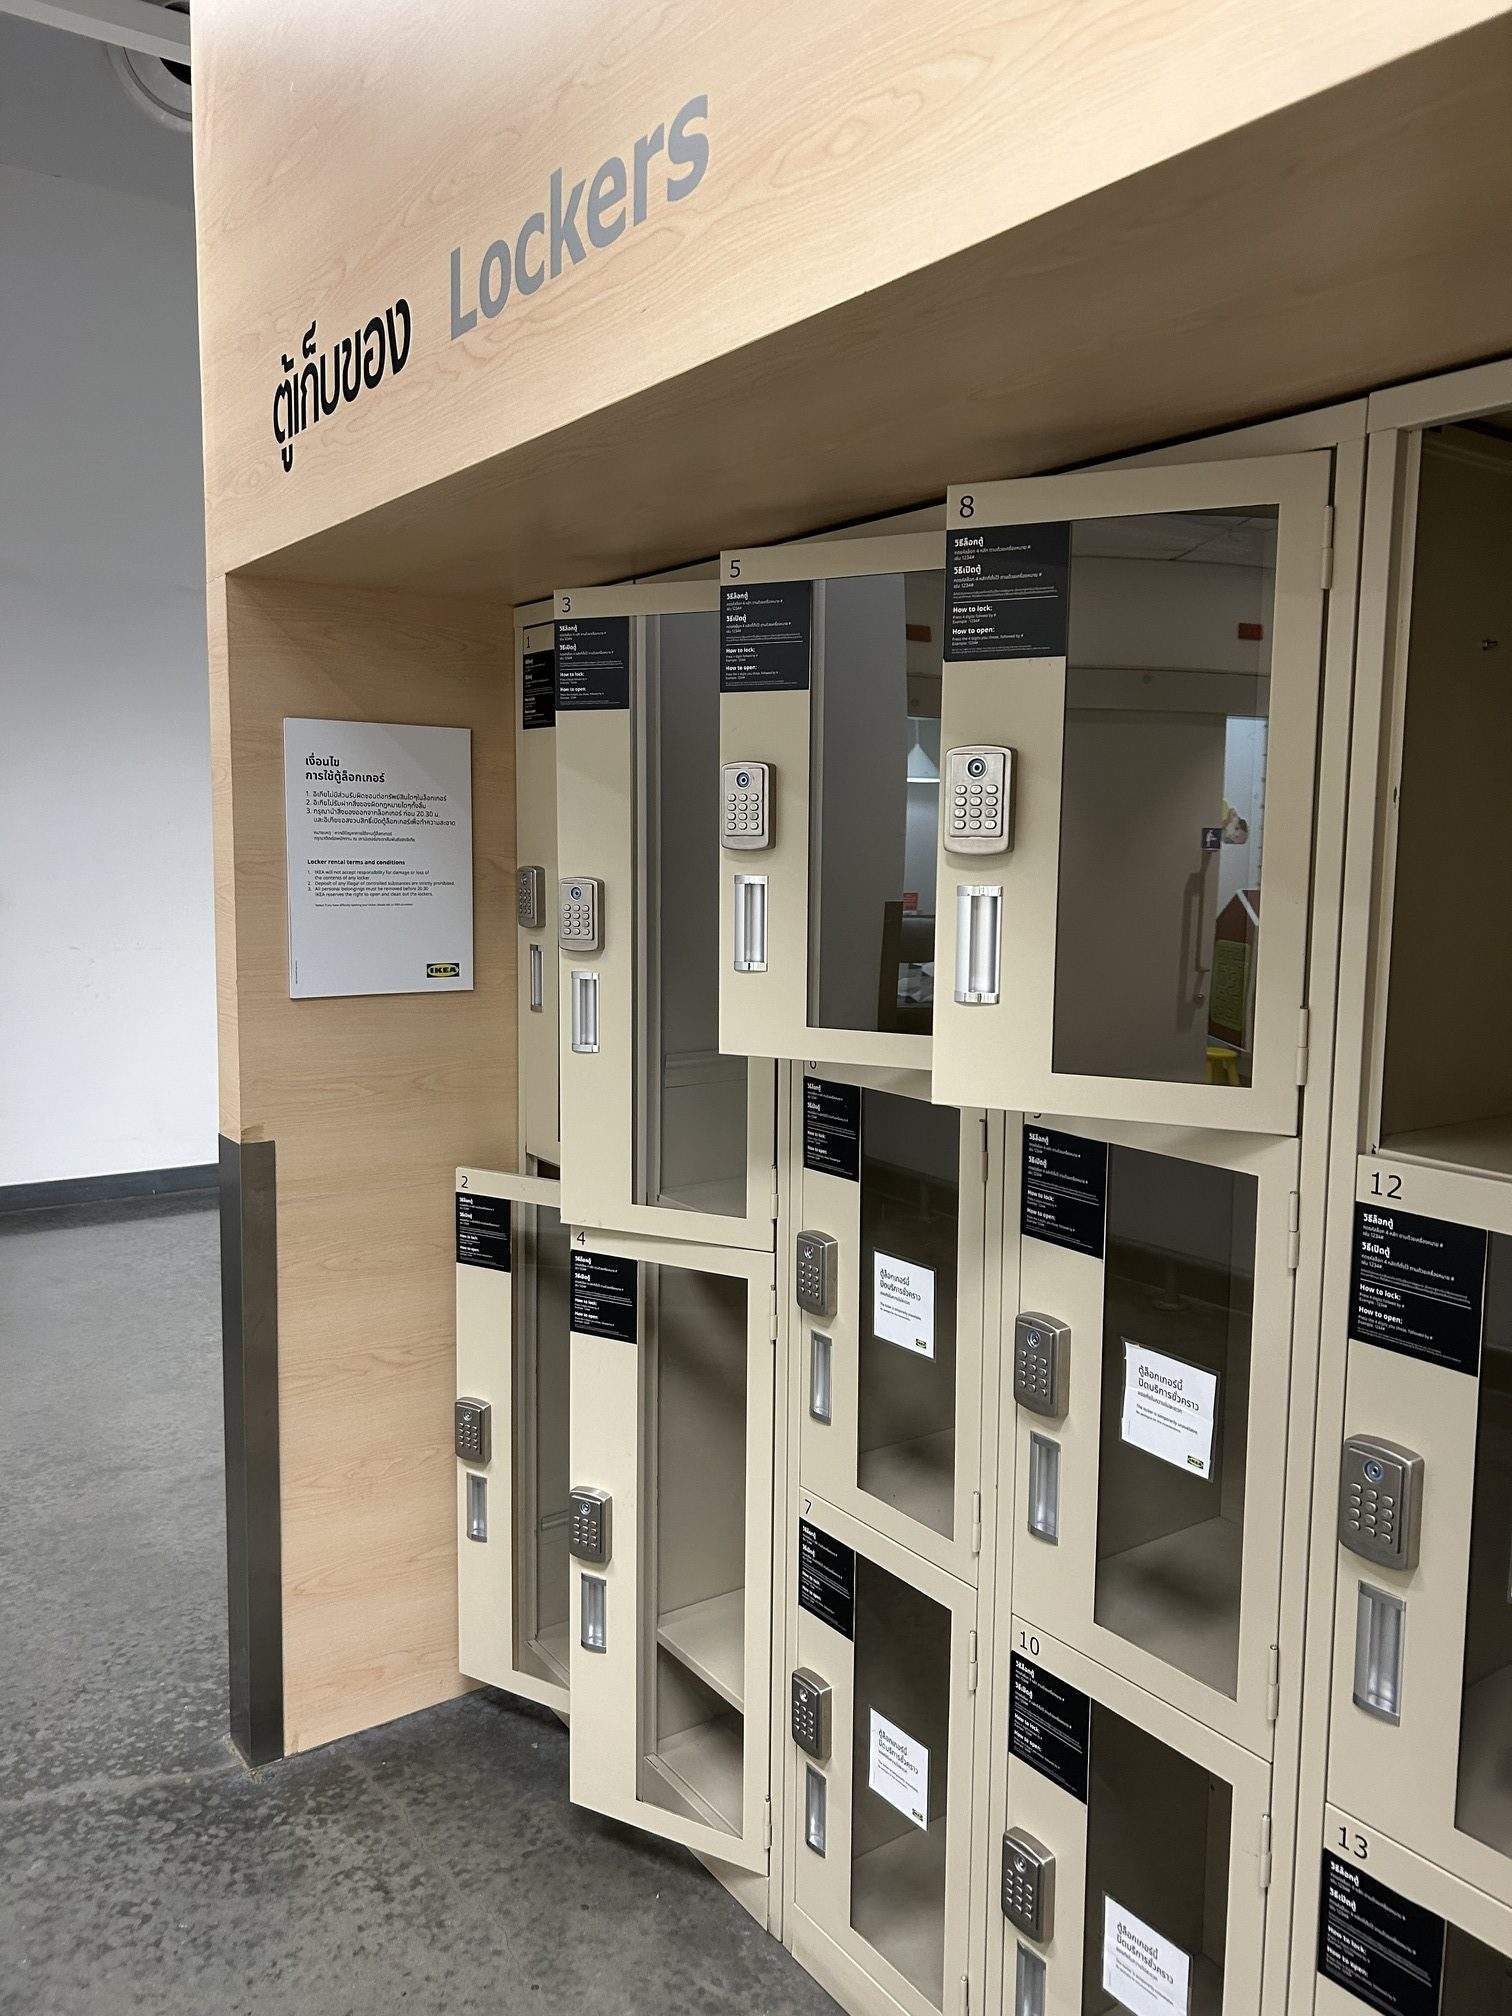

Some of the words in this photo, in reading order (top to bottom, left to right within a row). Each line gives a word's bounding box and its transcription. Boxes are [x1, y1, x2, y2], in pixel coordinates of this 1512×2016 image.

[451, 94, 708, 341] Lockers
[273, 297, 411, 472] ตู้เก็บของ
[960, 495, 974, 518] 8
[730, 560, 741, 578] 5
[562, 597, 571, 613] 3
[527, 636, 530, 648] 1
[306, 753, 340, 766] เงื่อนไข
[305, 770, 385, 783] การใช้ตู้ล็อกเกอร์
[429, 965, 459, 976] IKEA
[461, 1175, 469, 1188] 2
[1370, 1172, 1403, 1200] 12
[577, 1231, 585, 1245] 4
[1360, 1283, 1375, 1293] How
[1376, 1288, 1383, 1296] to
[1384, 1290, 1401, 1301] lock:
[1359, 1305, 1373, 1316] How
[1383, 1314, 1403, 1324] open:
[1138, 1365, 1183, 1392] ตู้ล็อกเกอร์นี้
[1138, 1378, 1200, 1411] ปิดบริการชั่วคราว
[805, 1499, 812, 1514] 7
[1020, 1631, 1039, 1655] 10
[1338, 1827, 1368, 1859] 13
